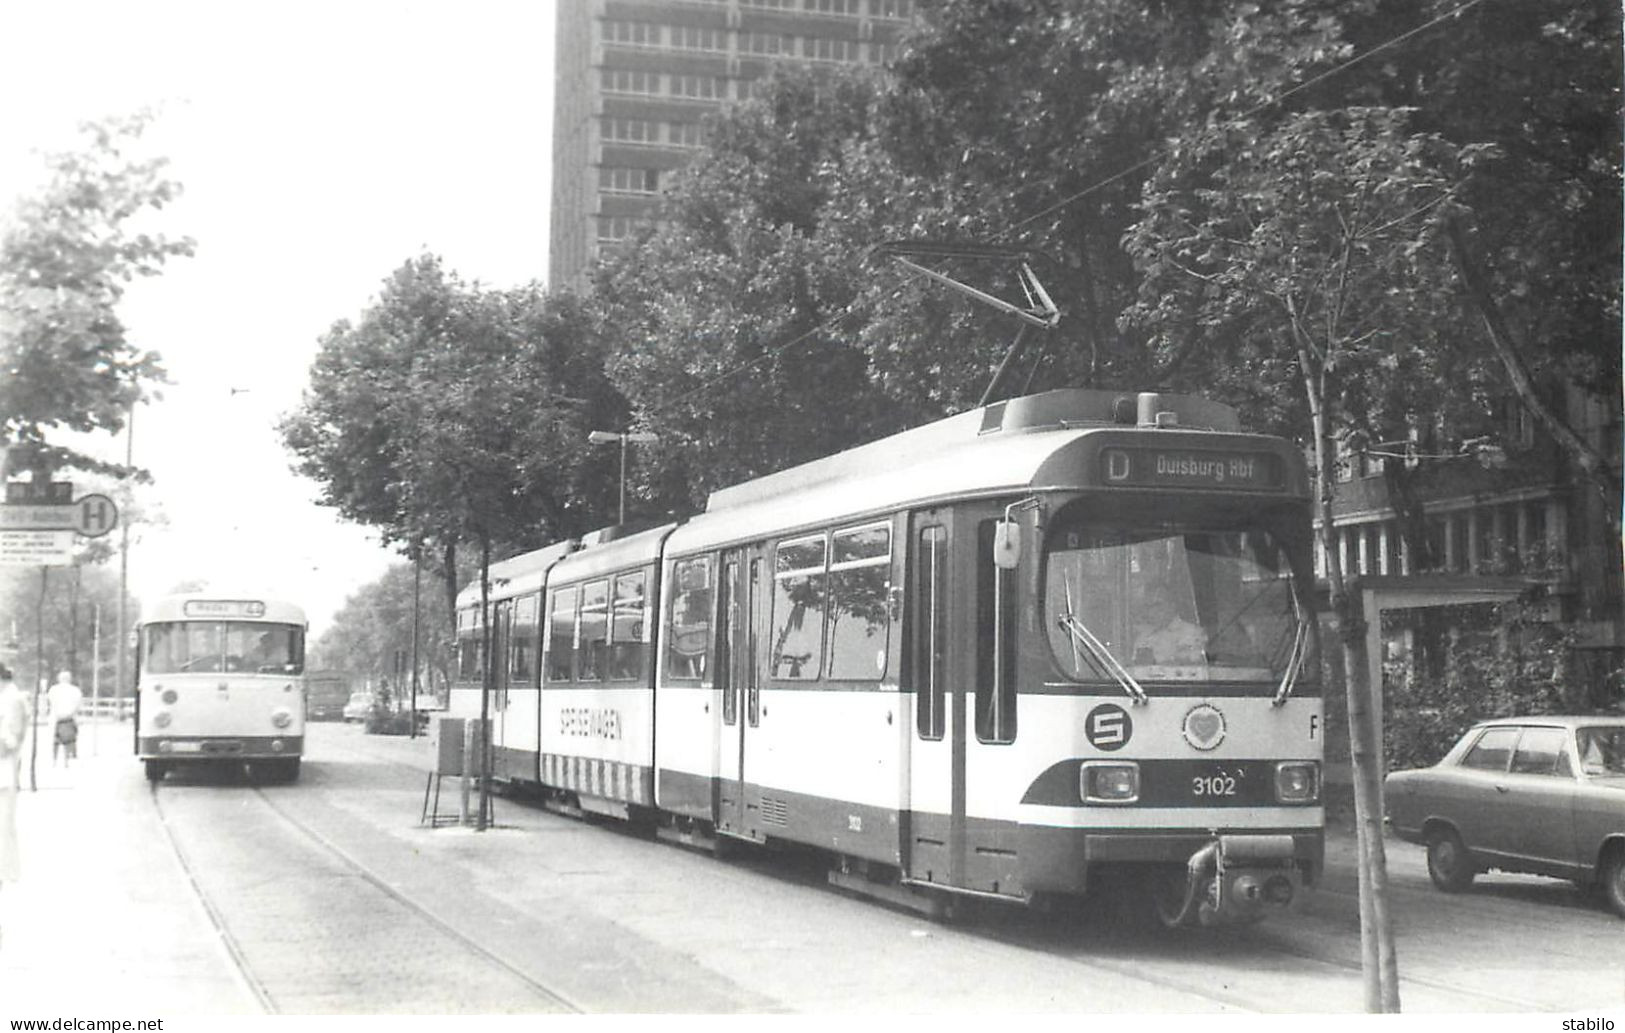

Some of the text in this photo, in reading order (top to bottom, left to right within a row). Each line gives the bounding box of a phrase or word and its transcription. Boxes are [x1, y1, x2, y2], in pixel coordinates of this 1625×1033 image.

[1109, 451, 1255, 483] D Duisburg Hbf
[82, 501, 106, 529] H
[560, 707, 622, 741] SPEISEWAGEN
[1310, 714, 1319, 740] F
[1192, 776, 1236, 797] 3102
